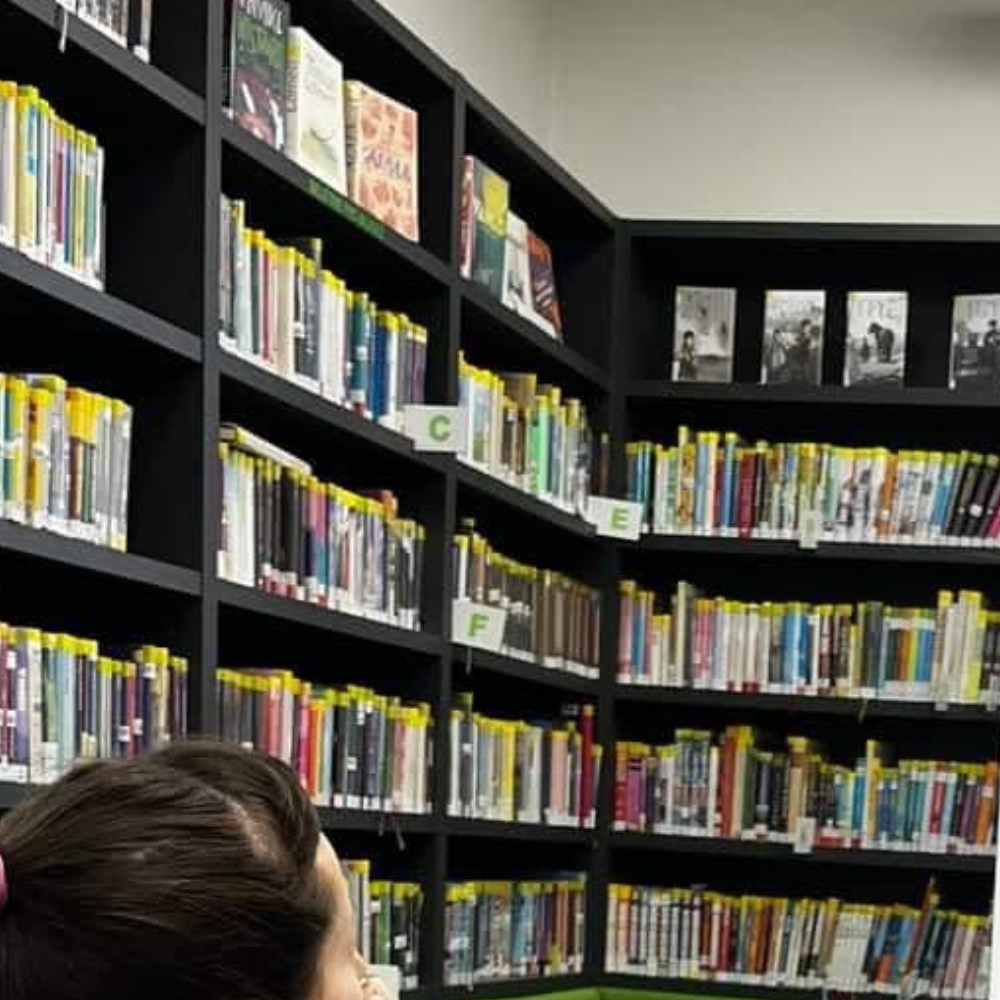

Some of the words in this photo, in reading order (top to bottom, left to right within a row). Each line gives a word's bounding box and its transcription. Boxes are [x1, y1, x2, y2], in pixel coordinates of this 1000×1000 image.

[429, 414, 450, 442] C
[610, 507, 629, 530] E
[467, 612, 489, 638] F
